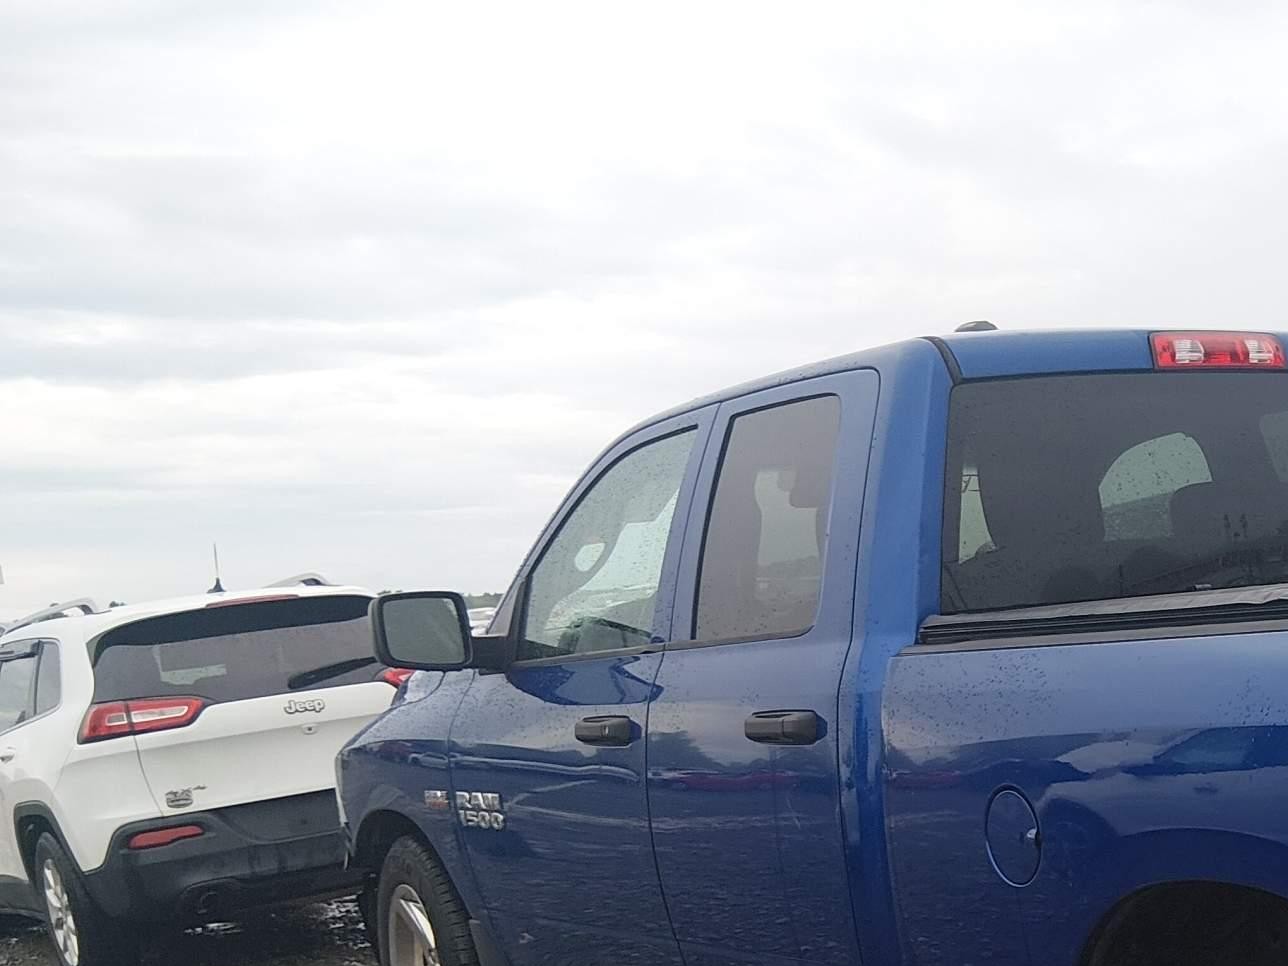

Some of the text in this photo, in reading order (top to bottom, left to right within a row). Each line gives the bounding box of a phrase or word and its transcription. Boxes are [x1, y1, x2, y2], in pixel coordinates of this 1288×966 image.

[283, 698, 326, 715] Jeep
[455, 791, 502, 810] RAM
[458, 809, 505, 832] 1500
